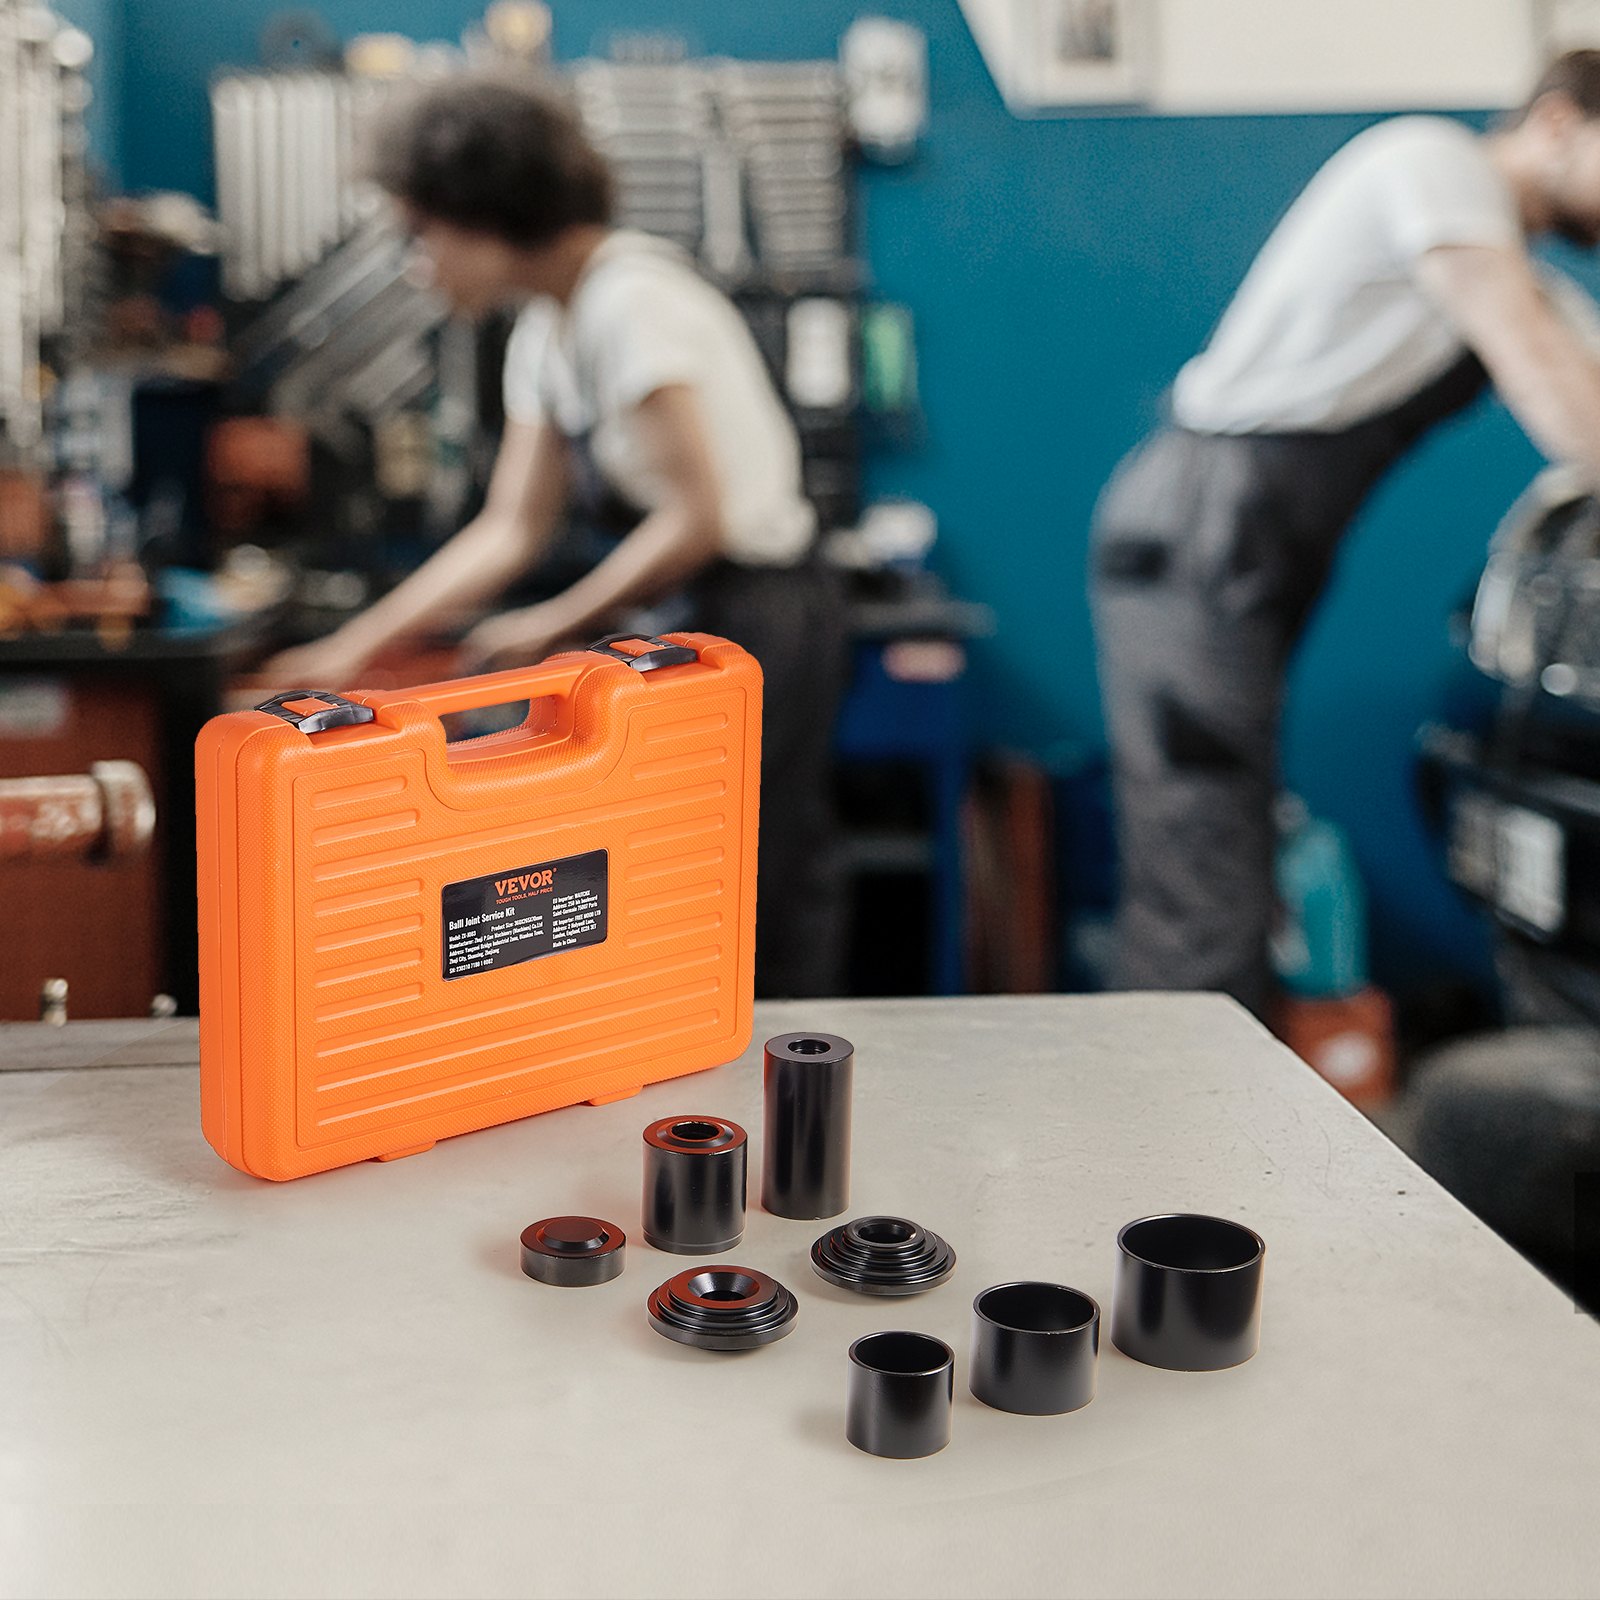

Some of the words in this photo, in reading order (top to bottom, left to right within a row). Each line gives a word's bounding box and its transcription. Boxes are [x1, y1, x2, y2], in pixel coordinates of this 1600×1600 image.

[495, 870, 552, 896] VEVOR
[581, 895, 597, 903] boulevard
[465, 916, 480, 927] Joint
[482, 911, 504, 922] Service
[506, 907, 515, 917] Kit
[449, 940, 473, 949] Manufacturer:
[493, 938, 509, 946] Industrial
